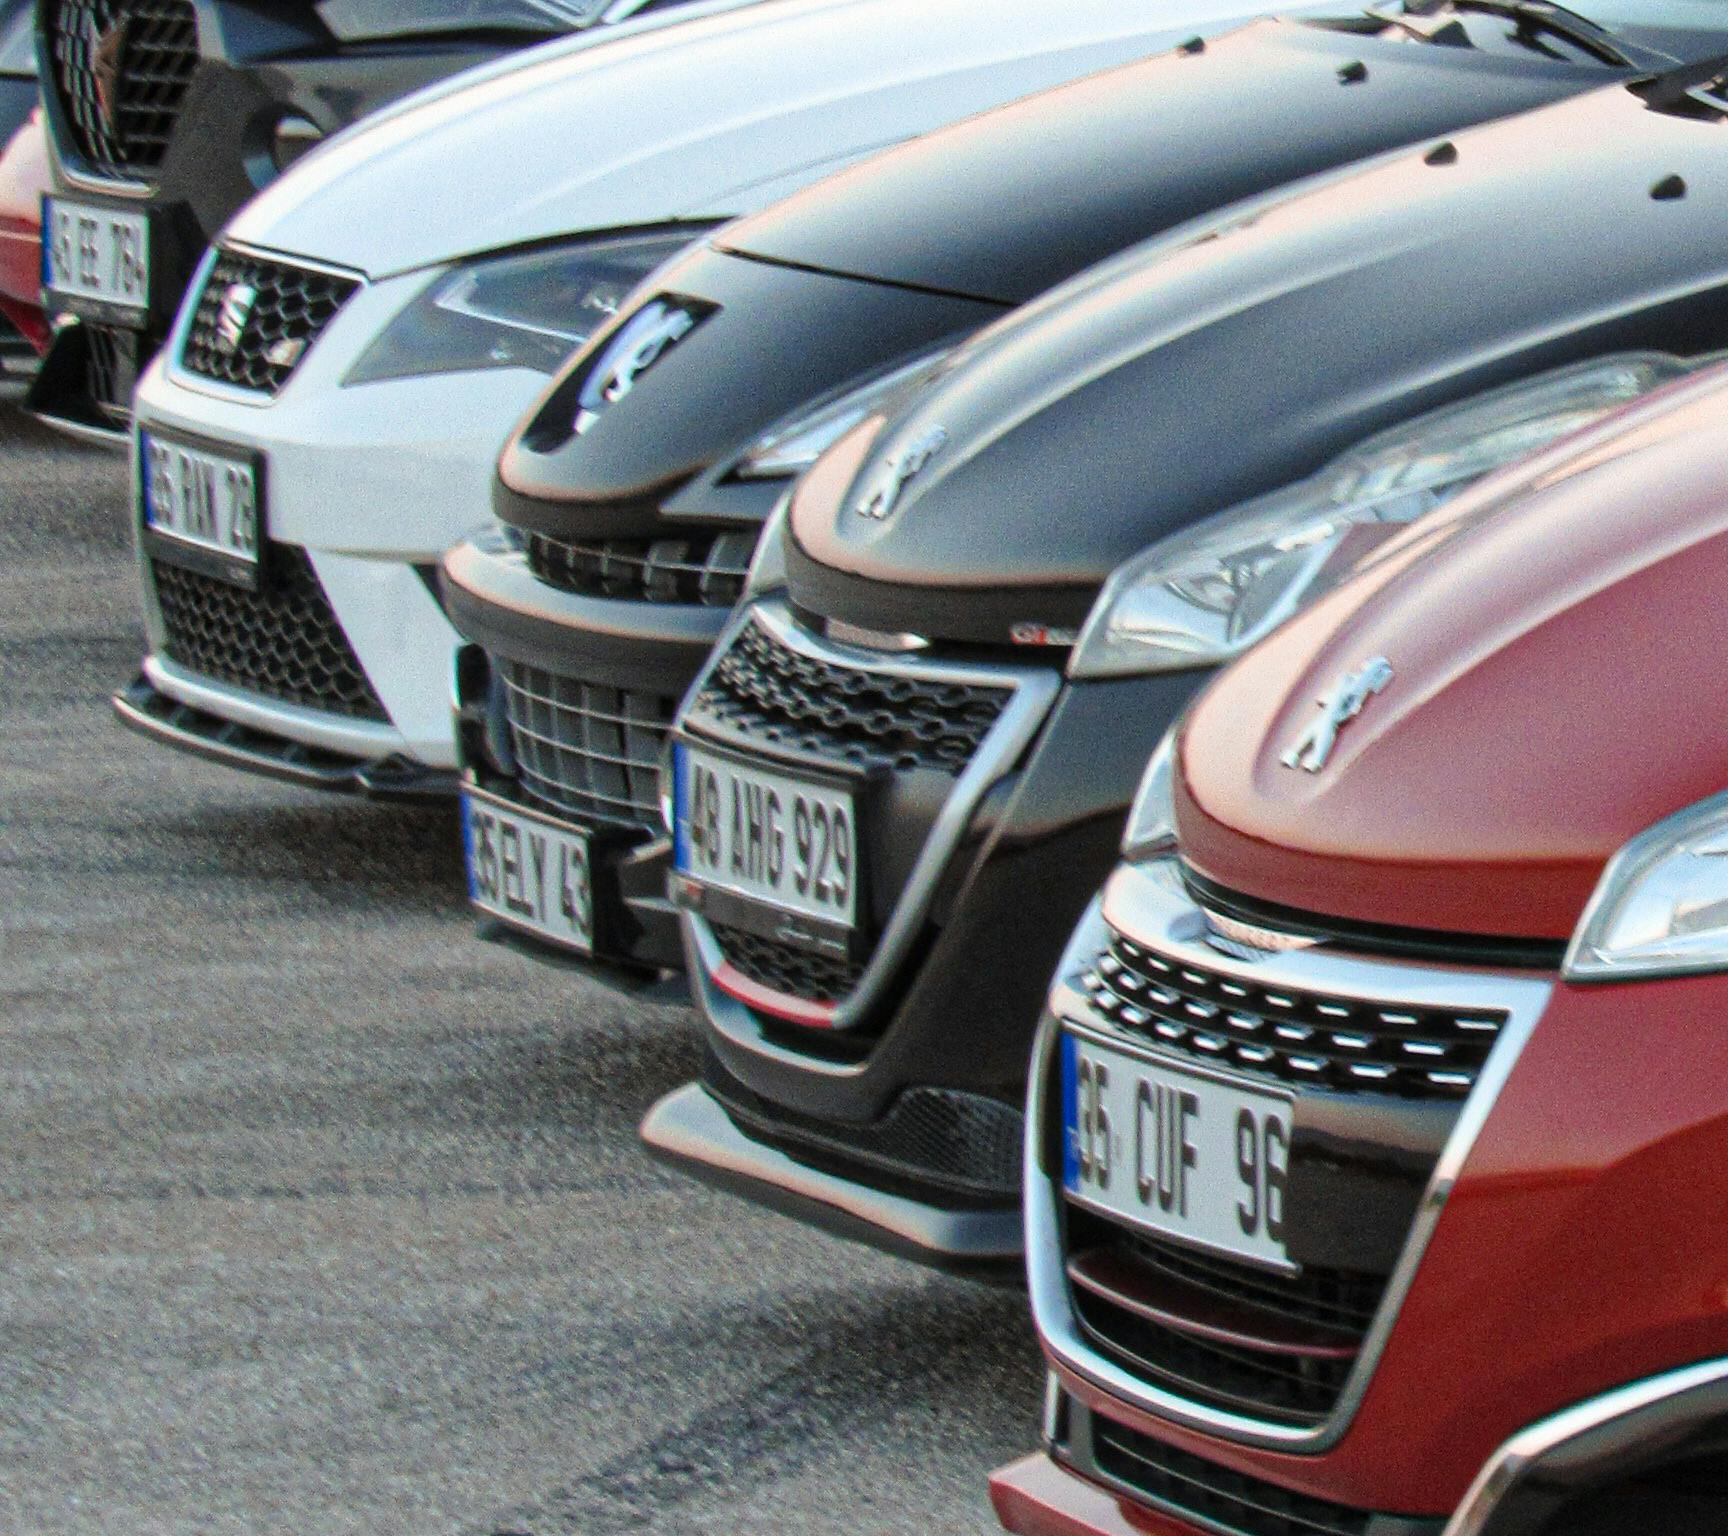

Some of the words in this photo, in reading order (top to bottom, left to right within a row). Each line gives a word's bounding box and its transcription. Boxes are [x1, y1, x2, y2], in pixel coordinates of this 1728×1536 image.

[501, 815, 548, 924] ELY
[731, 774, 785, 889] AHG
[795, 792, 850, 909] 929
[1078, 1054, 1112, 1190] 35
[1135, 1076, 1200, 1219] CUF
[1237, 1106, 1291, 1243] 96
